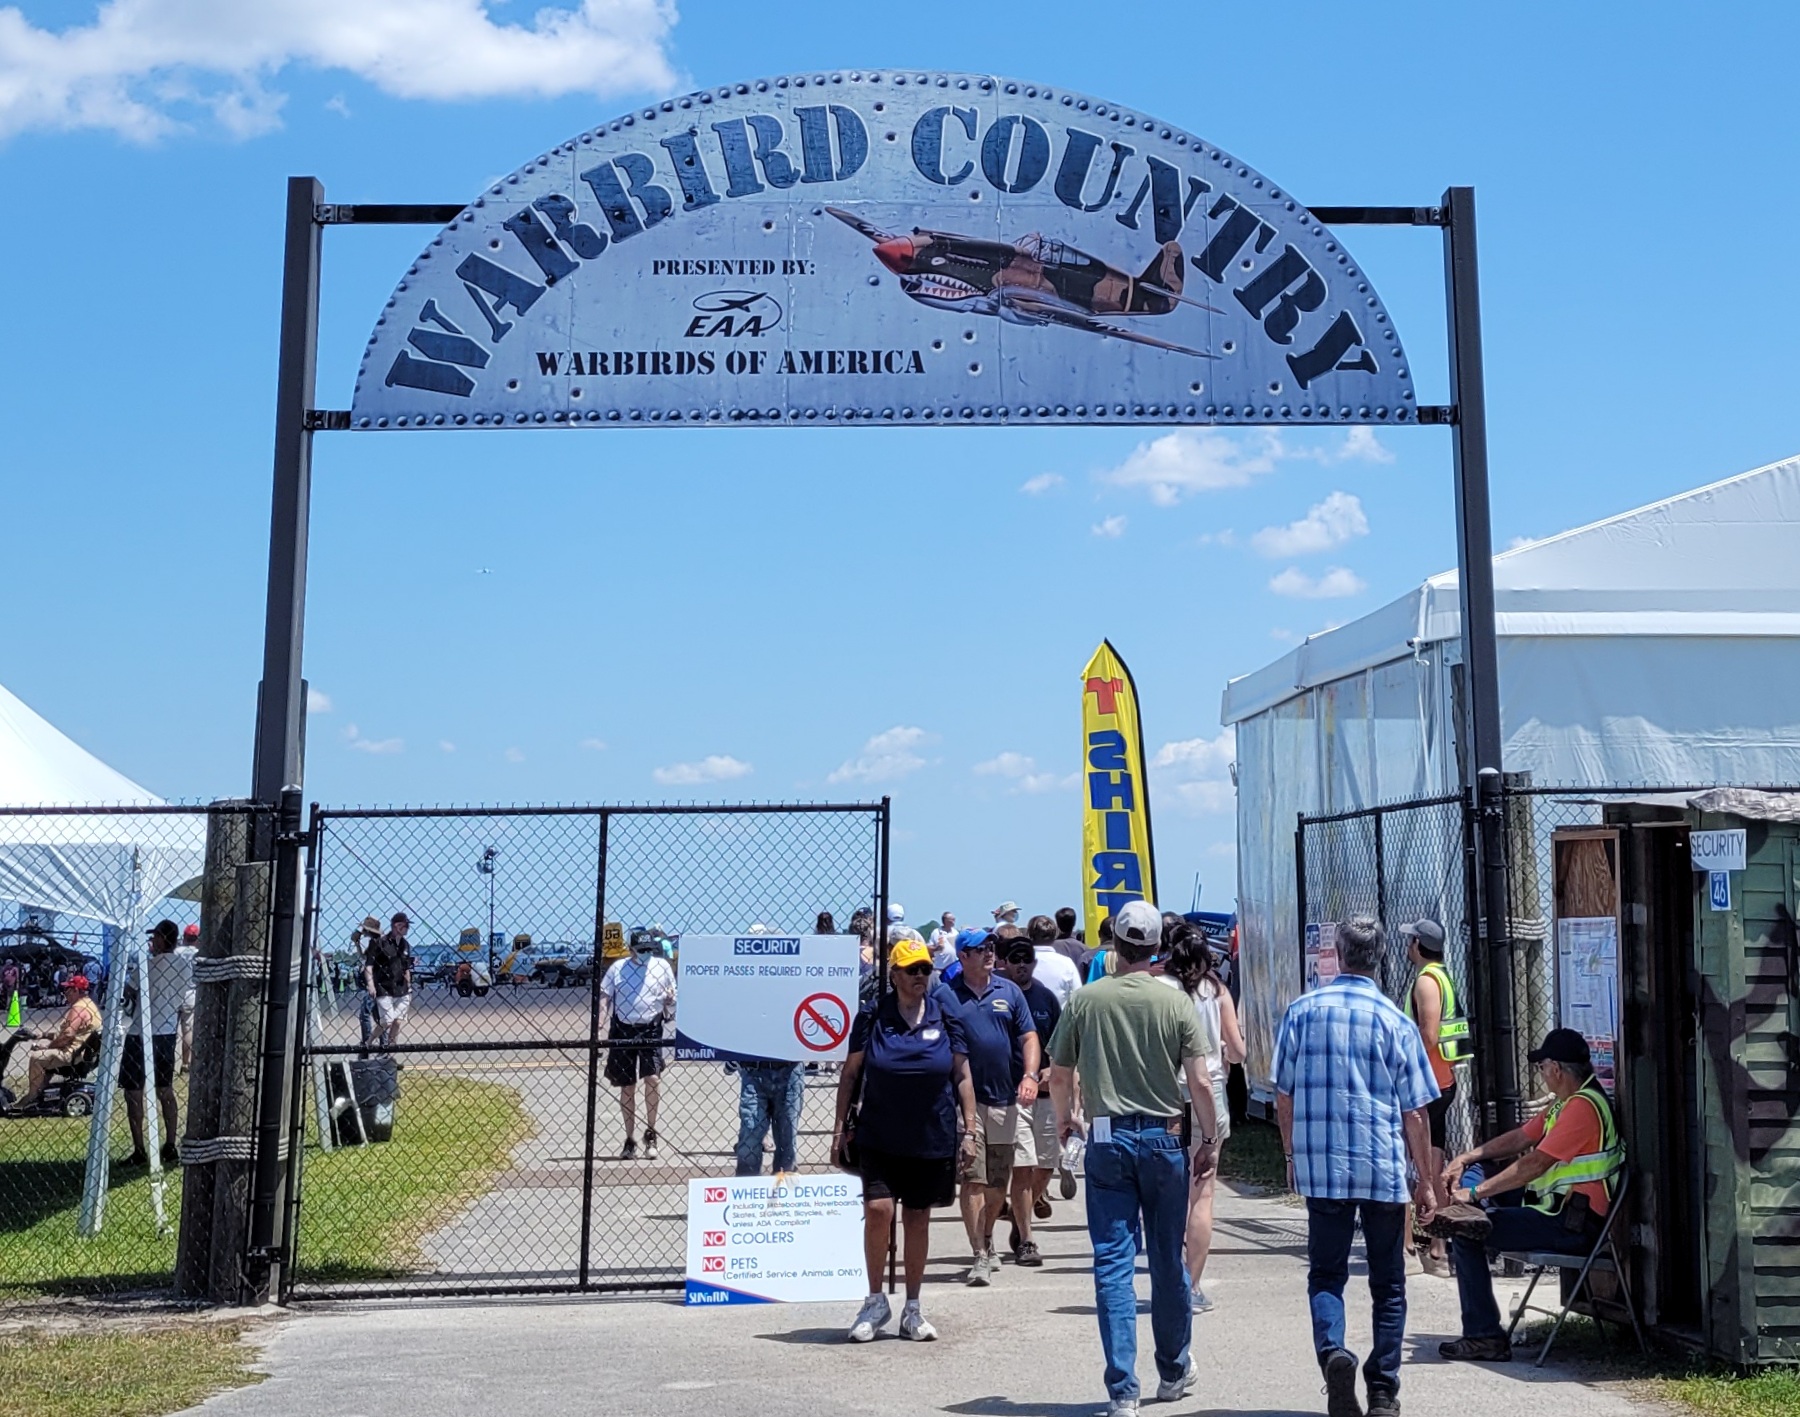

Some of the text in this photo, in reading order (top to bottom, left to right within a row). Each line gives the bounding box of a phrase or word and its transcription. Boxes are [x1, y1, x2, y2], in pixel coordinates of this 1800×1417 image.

[385, 103, 1379, 397] WARBIRD COUNTRY
[652, 259, 816, 276] PRESENTED BY:
[684, 315, 762, 338] EAA
[536, 350, 925, 376] WARBIRDS OF AMERICA
[1690, 833, 1744, 857] SECURITY
[1713, 881, 1726, 903] 46
[735, 939, 799, 954] SECURITY
[684, 965, 854, 977] PROPER PASSES REQUIRED FOR ENTRY
[705, 1185, 847, 1202] NO WHEELED DEVICES
[732, 1201, 764, 1210] Including
[774, 1219, 811, 1228] Compliant
[704, 1231, 794, 1246] NO COOLERS
[702, 1257, 758, 1271] NO PETS
[723, 1268, 863, 1280] (Certified Service Animals ONLY)
